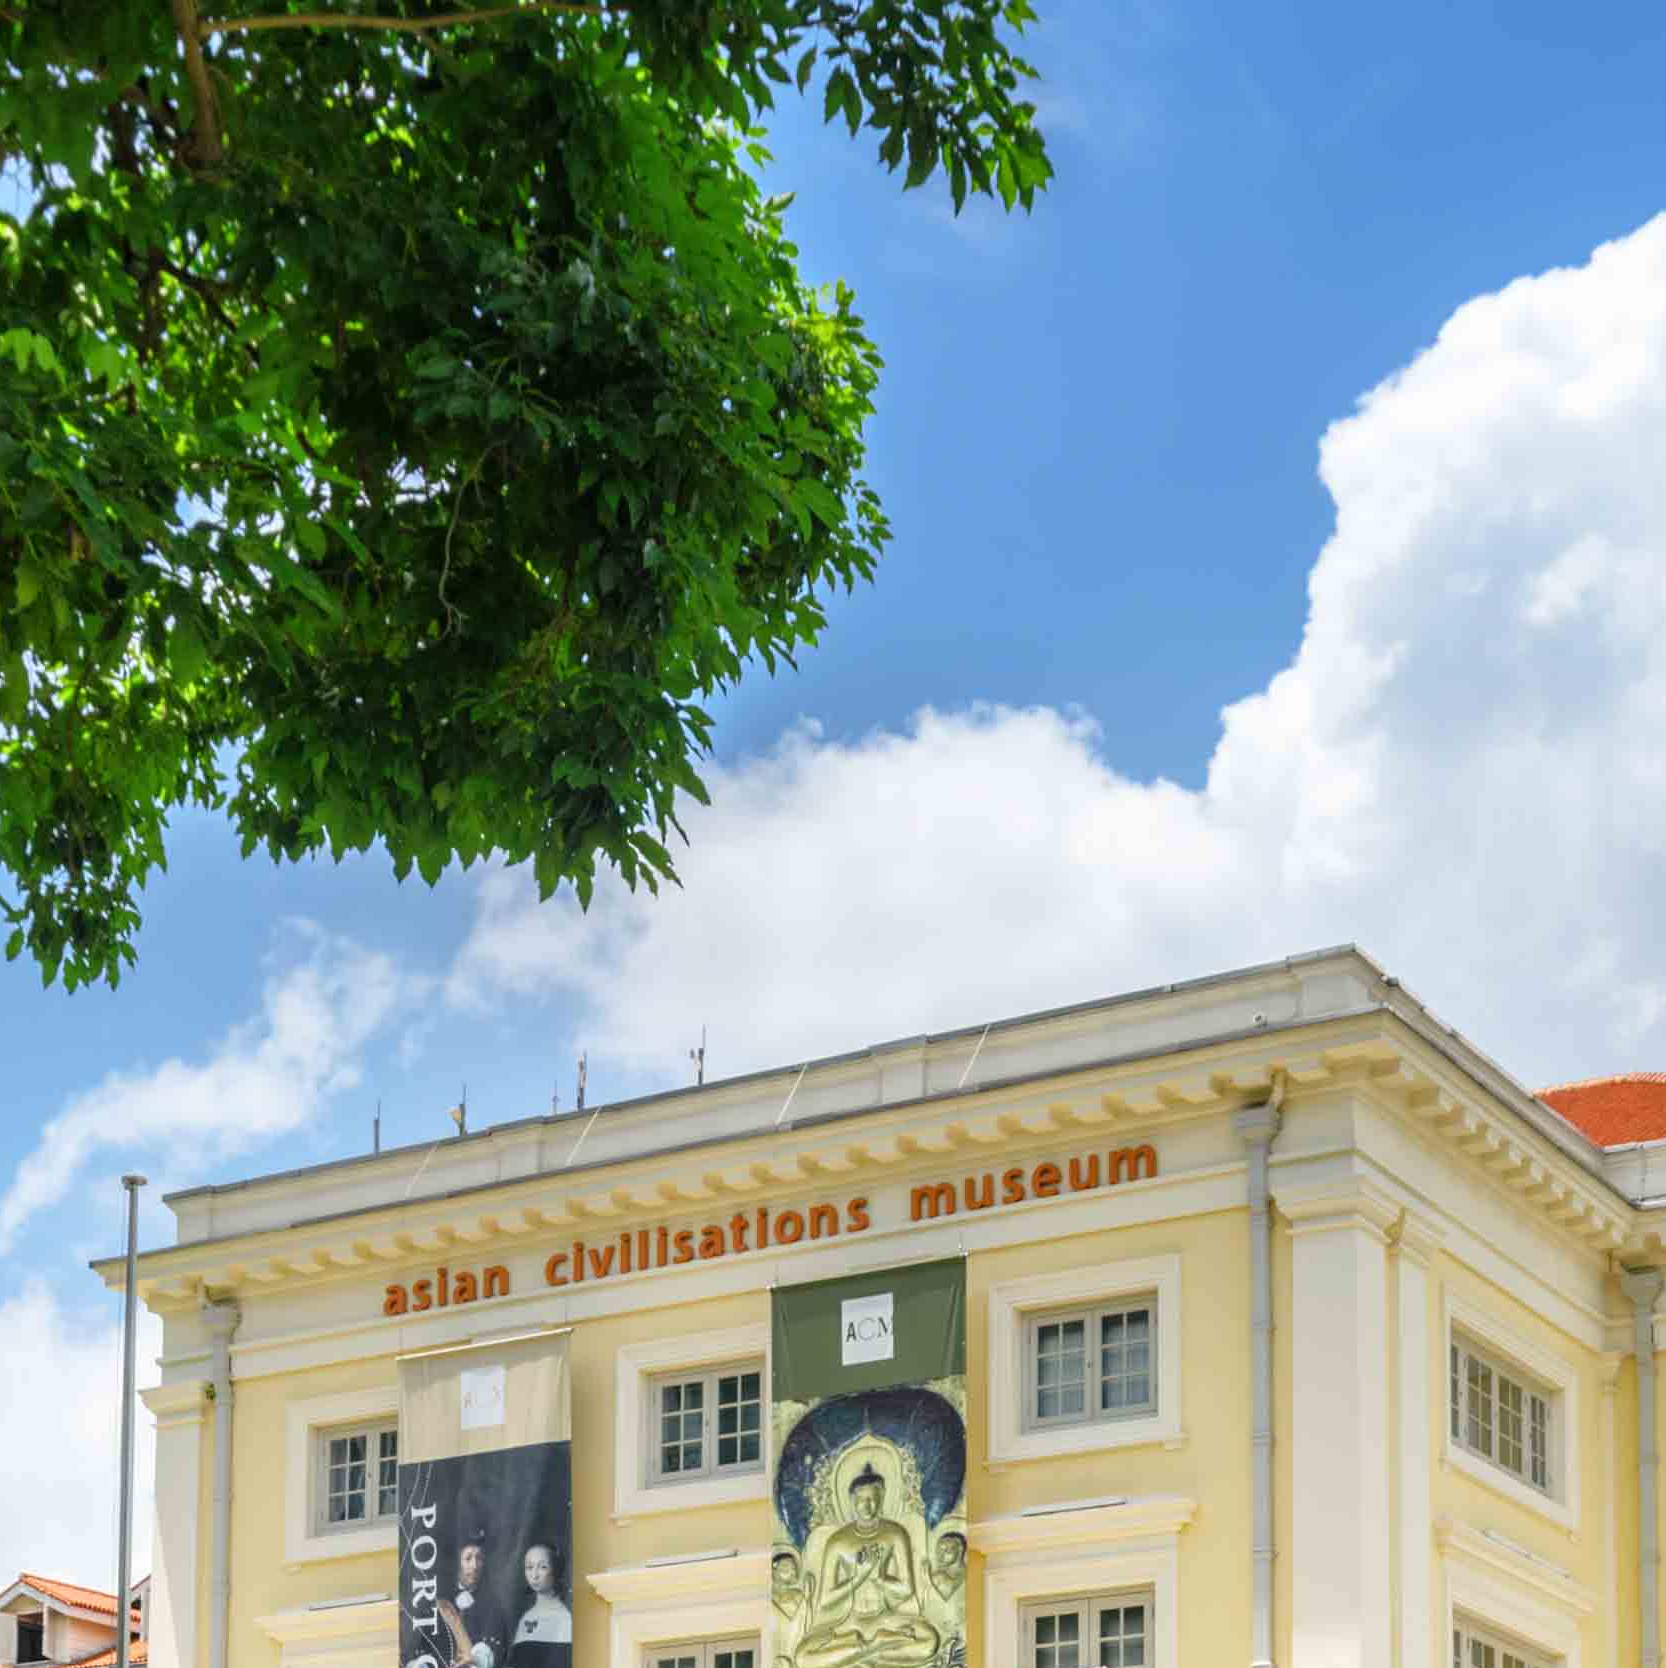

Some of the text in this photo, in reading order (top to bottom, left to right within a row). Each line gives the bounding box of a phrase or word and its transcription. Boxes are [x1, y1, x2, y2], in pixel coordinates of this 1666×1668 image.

[383, 1144, 1160, 1317] asian civilisations museum
[410, 1503, 437, 1636] PORT
